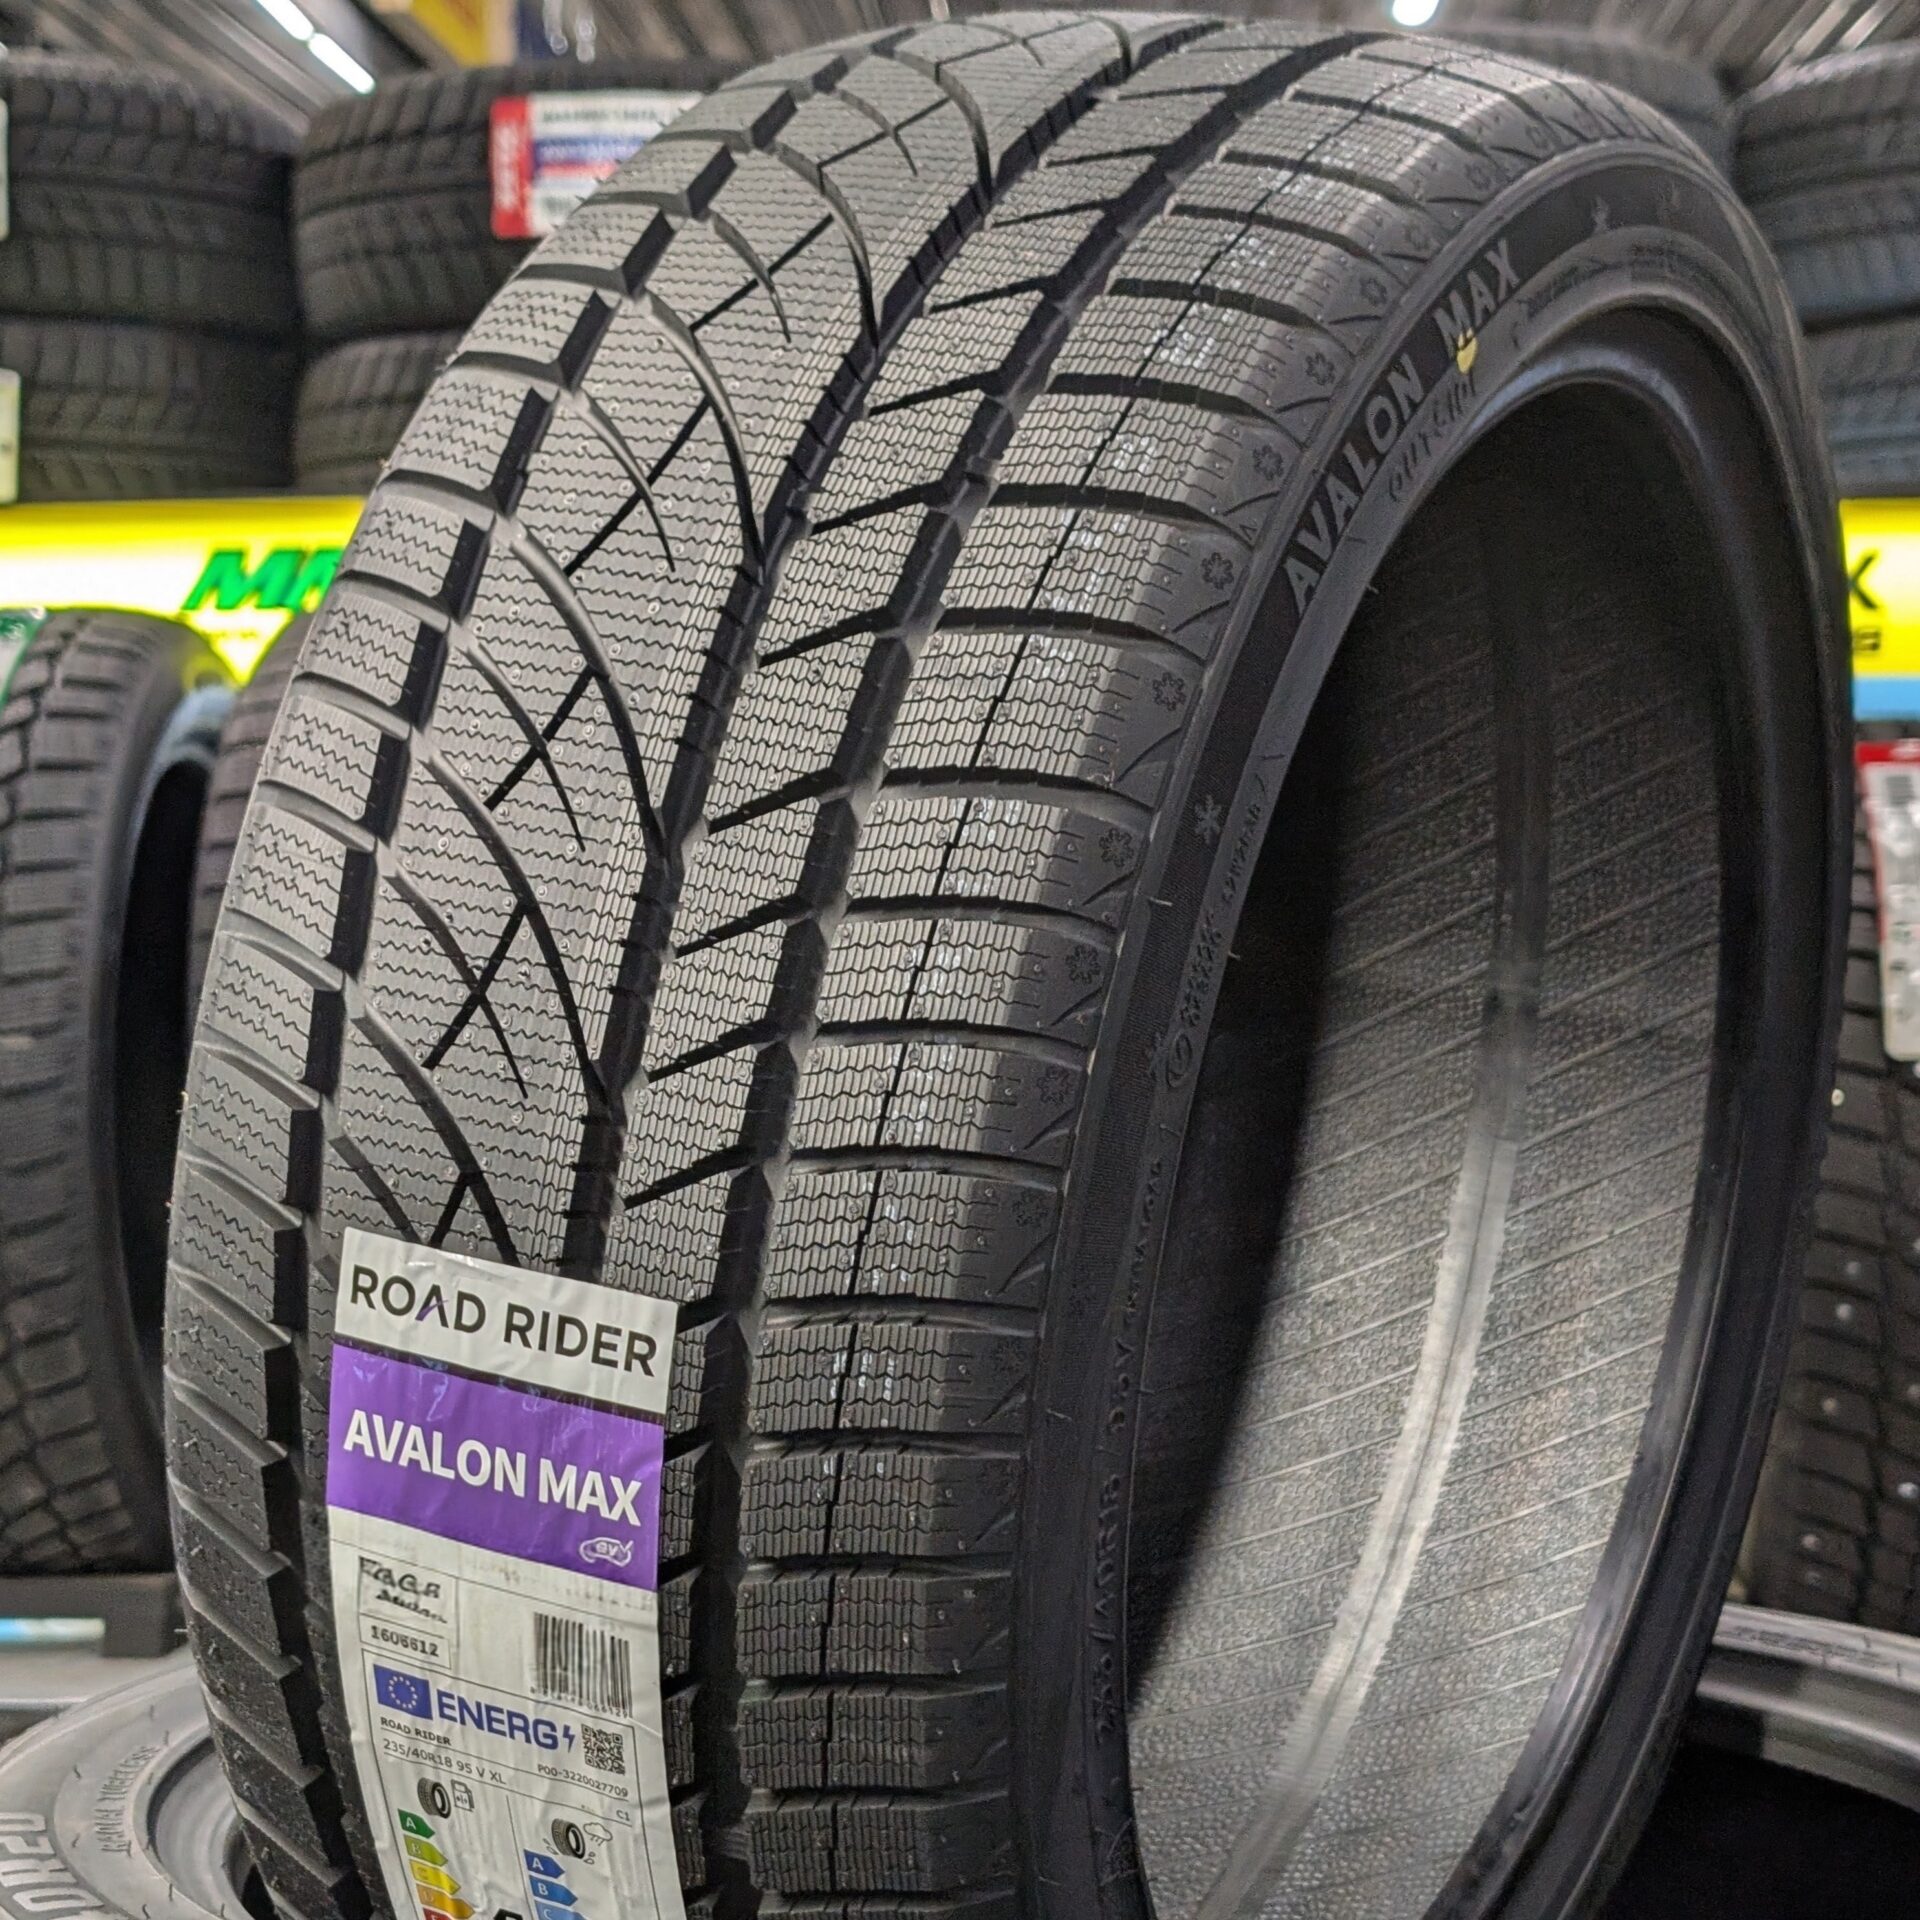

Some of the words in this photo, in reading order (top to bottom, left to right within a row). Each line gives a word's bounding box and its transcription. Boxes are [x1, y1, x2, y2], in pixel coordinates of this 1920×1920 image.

[1283, 353, 1424, 619] AVALON
[1433, 238, 1520, 360] MAX
[350, 1264, 487, 1334] ROAD
[503, 1301, 657, 1378] RIDER
[343, 1408, 526, 1498] AVALON
[538, 1458, 642, 1527] MAX
[380, 1716, 411, 1735] ROAD
[414, 1726, 452, 1746] RIDER
[436, 1688, 559, 1750] ENERG
[383, 1738, 453, 1768] 235/40R18
[456, 1757, 473, 1775] 95
[475, 1765, 487, 1779] V
[488, 1771, 507, 1785] XL
[405, 1816, 417, 1830] A
[615, 1809, 631, 1822] C1
[531, 1857, 545, 1872] A
[537, 1883, 549, 1896] B
